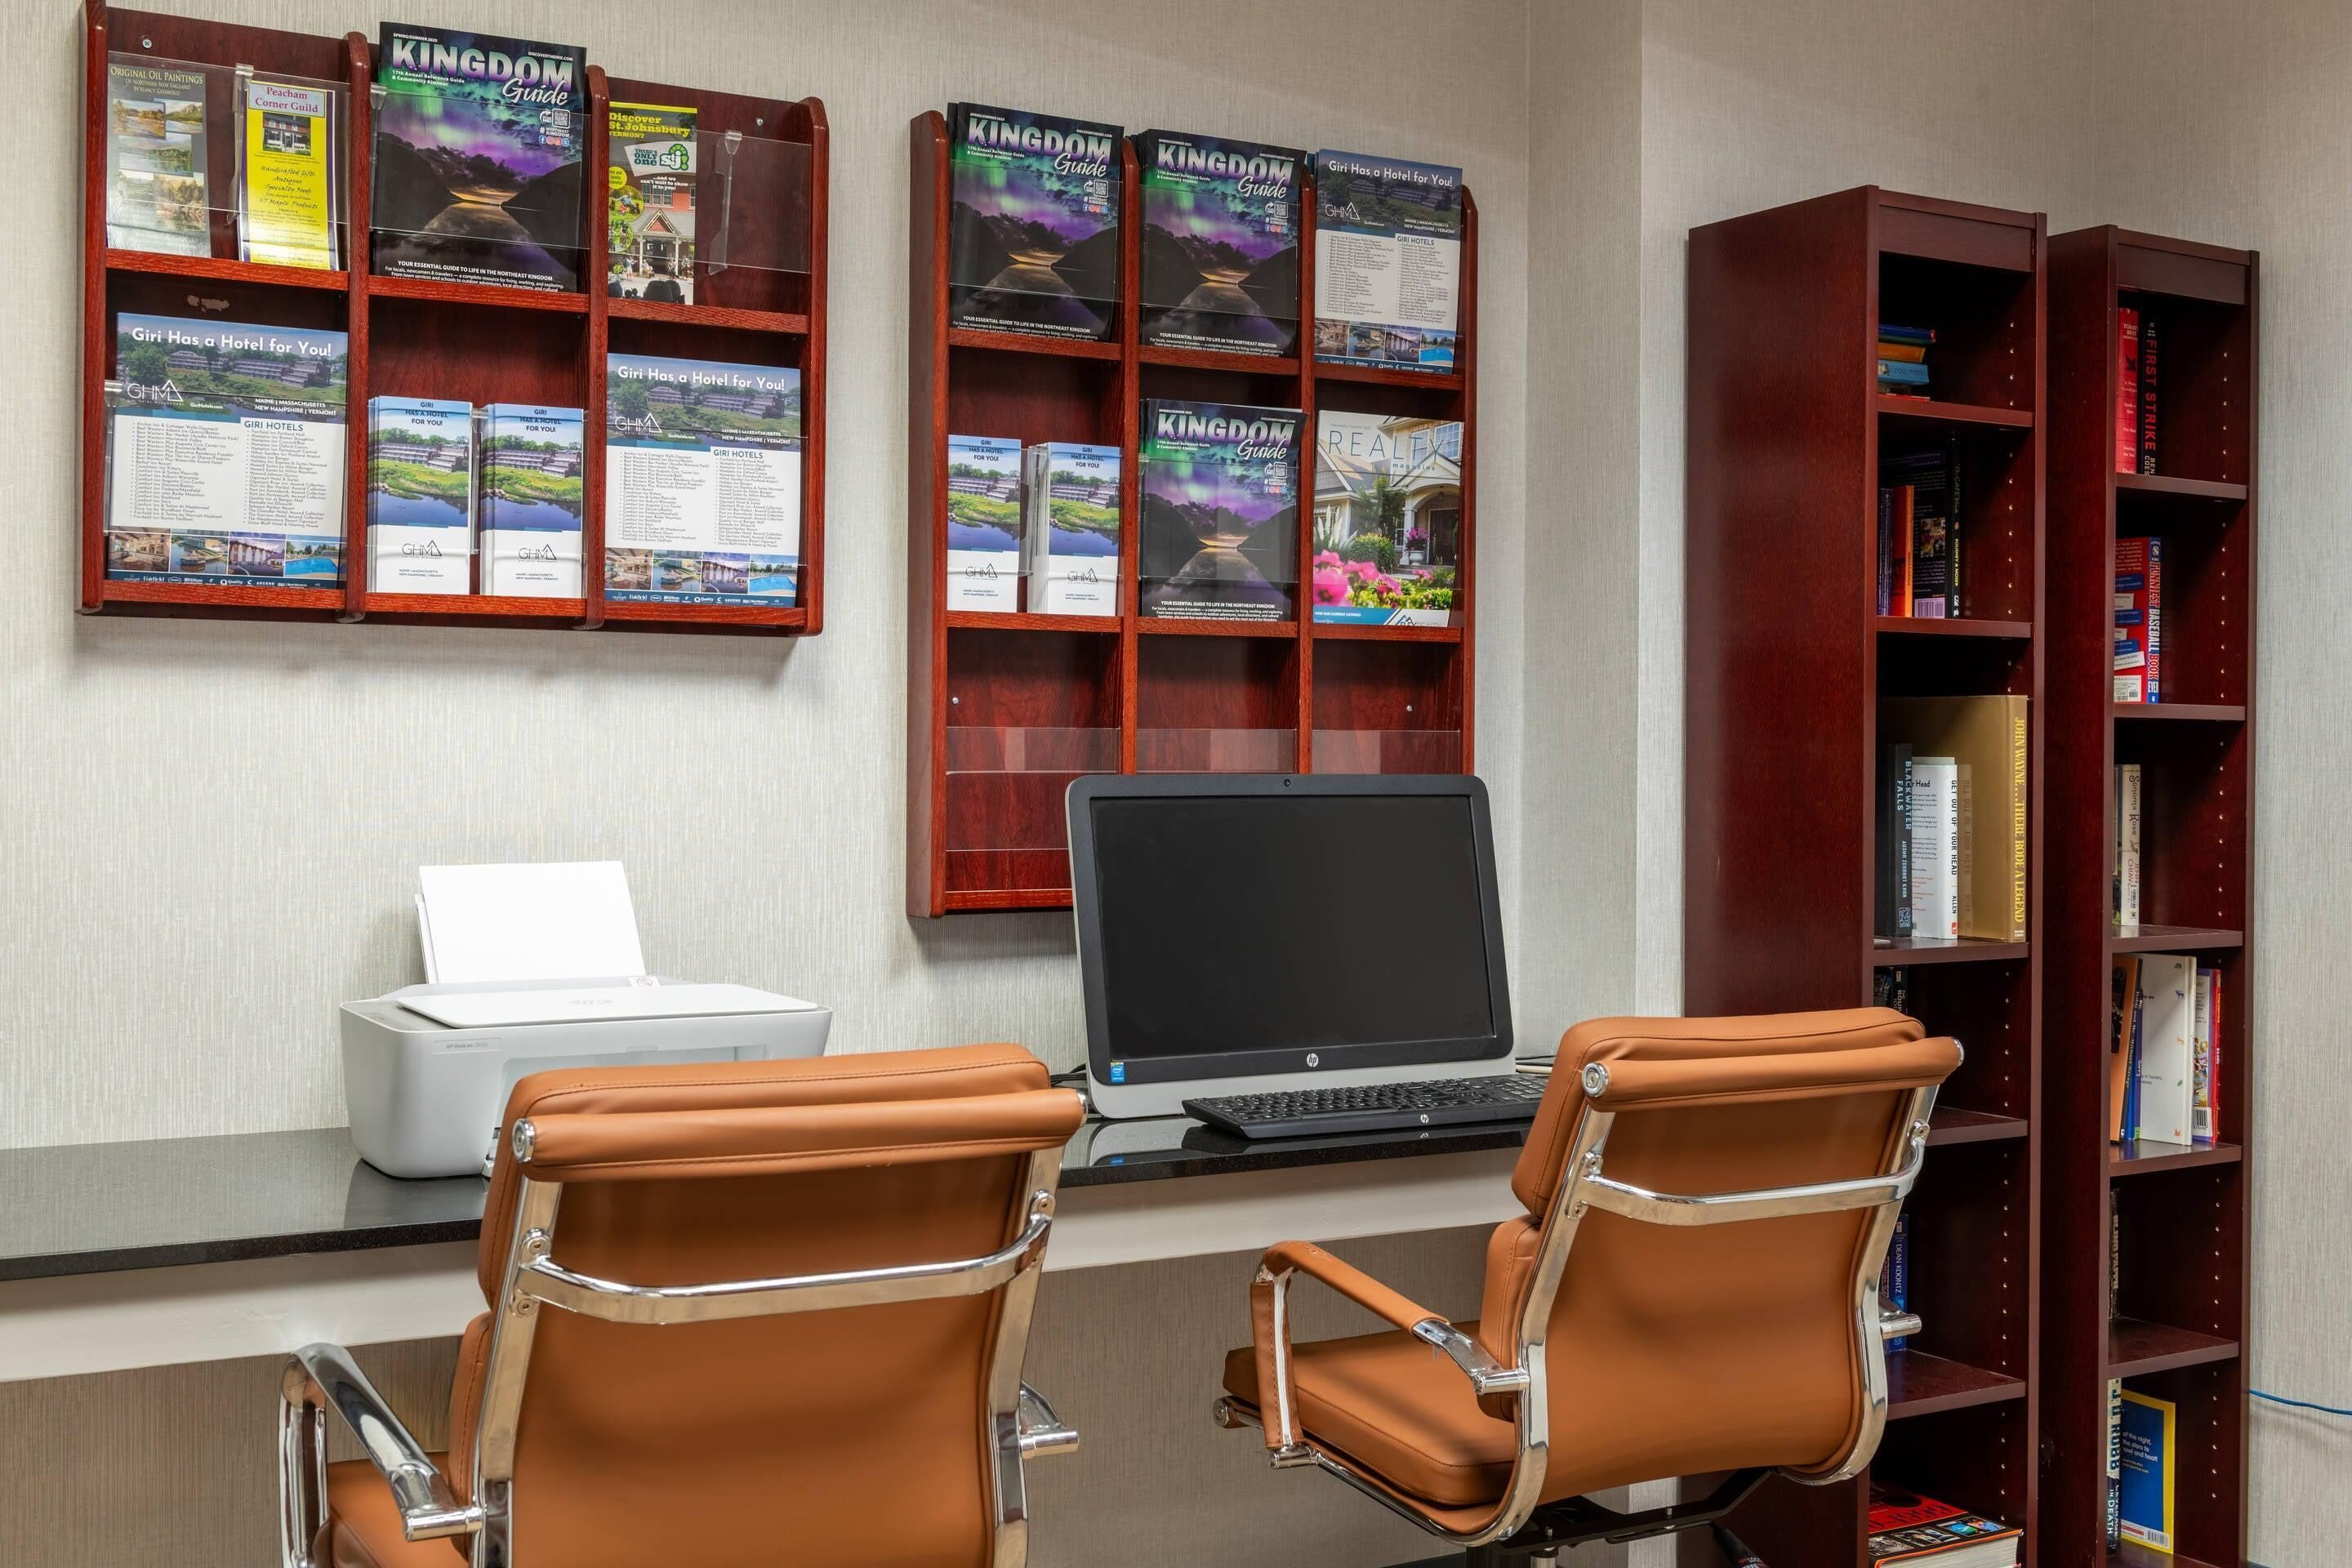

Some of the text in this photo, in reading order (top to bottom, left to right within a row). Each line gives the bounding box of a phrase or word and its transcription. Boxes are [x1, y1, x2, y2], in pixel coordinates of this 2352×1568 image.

[392, 38, 572, 91] KINGDOM
[110, 66, 203, 84] ORIGINAL OIL PAINTINGS
[267, 87, 308, 99] Peacham
[502, 78, 568, 105] Guide
[255, 97, 318, 113] Corner Guild
[608, 112, 662, 124] Discover
[608, 121, 690, 138] St. Johnsbury
[969, 118, 1112, 166] KINGDOM
[261, 166, 315, 177] Handcrafted Gifts
[1054, 153, 1107, 177] Guide
[1158, 143, 1294, 187] KINGDOM
[1329, 160, 1348, 173] Giri
[1351, 163, 1370, 176] Has
[1384, 167, 1410, 181] Hotel
[1414, 172, 1428, 184] for
[1432, 174, 1453, 187] You!
[1238, 176, 1287, 198] Guide
[1411, 237, 1435, 246] HOTELS
[414, 261, 442, 270] ESSENTIAL
[497, 270, 528, 278] NORTHEAST
[131, 327, 332, 357] Giri Has a Hotel for You!
[618, 366, 784, 390] Giri Has a Hotel for You!
[278, 399, 326, 408] MASSACHUSETTS
[2145, 340, 2157, 450] FIRST STRIKE
[270, 406, 304, 414] HAMPSHIRE
[406, 409, 419, 417] HAS
[244, 421, 304, 432] GIRI HOTELS
[1158, 413, 1295, 447] KINGDOM
[733, 451, 763, 459] HOTELS
[1237, 439, 1287, 461] Guide
[1329, 430, 1444, 462] REALTY
[1392, 463, 1436, 471] magazine
[2149, 562, 2160, 680] FUNNIEST BASEBALL BOOK
[2014, 717, 2025, 746] JOHN
[1915, 778, 1931, 788] Head
[1896, 780, 1904, 811] FALLS
[2129, 774, 2140, 836] Sonoma Rose
[1951, 817, 1958, 827] OF
[2014, 840, 2025, 870] RODE
[2014, 871, 2024, 880] A
[2014, 882, 2024, 923] LEGEND
[1307, 1053, 1319, 1067] hp
[2110, 1423, 2121, 1471] ROBB
[2129, 1432, 2137, 1441] the
[2137, 1435, 2152, 1446] night,
[2132, 1442, 2144, 1450] stars
[2123, 1447, 2158, 1462] owl and hoot!
[2107, 1489, 2115, 1535] IN DEATH
